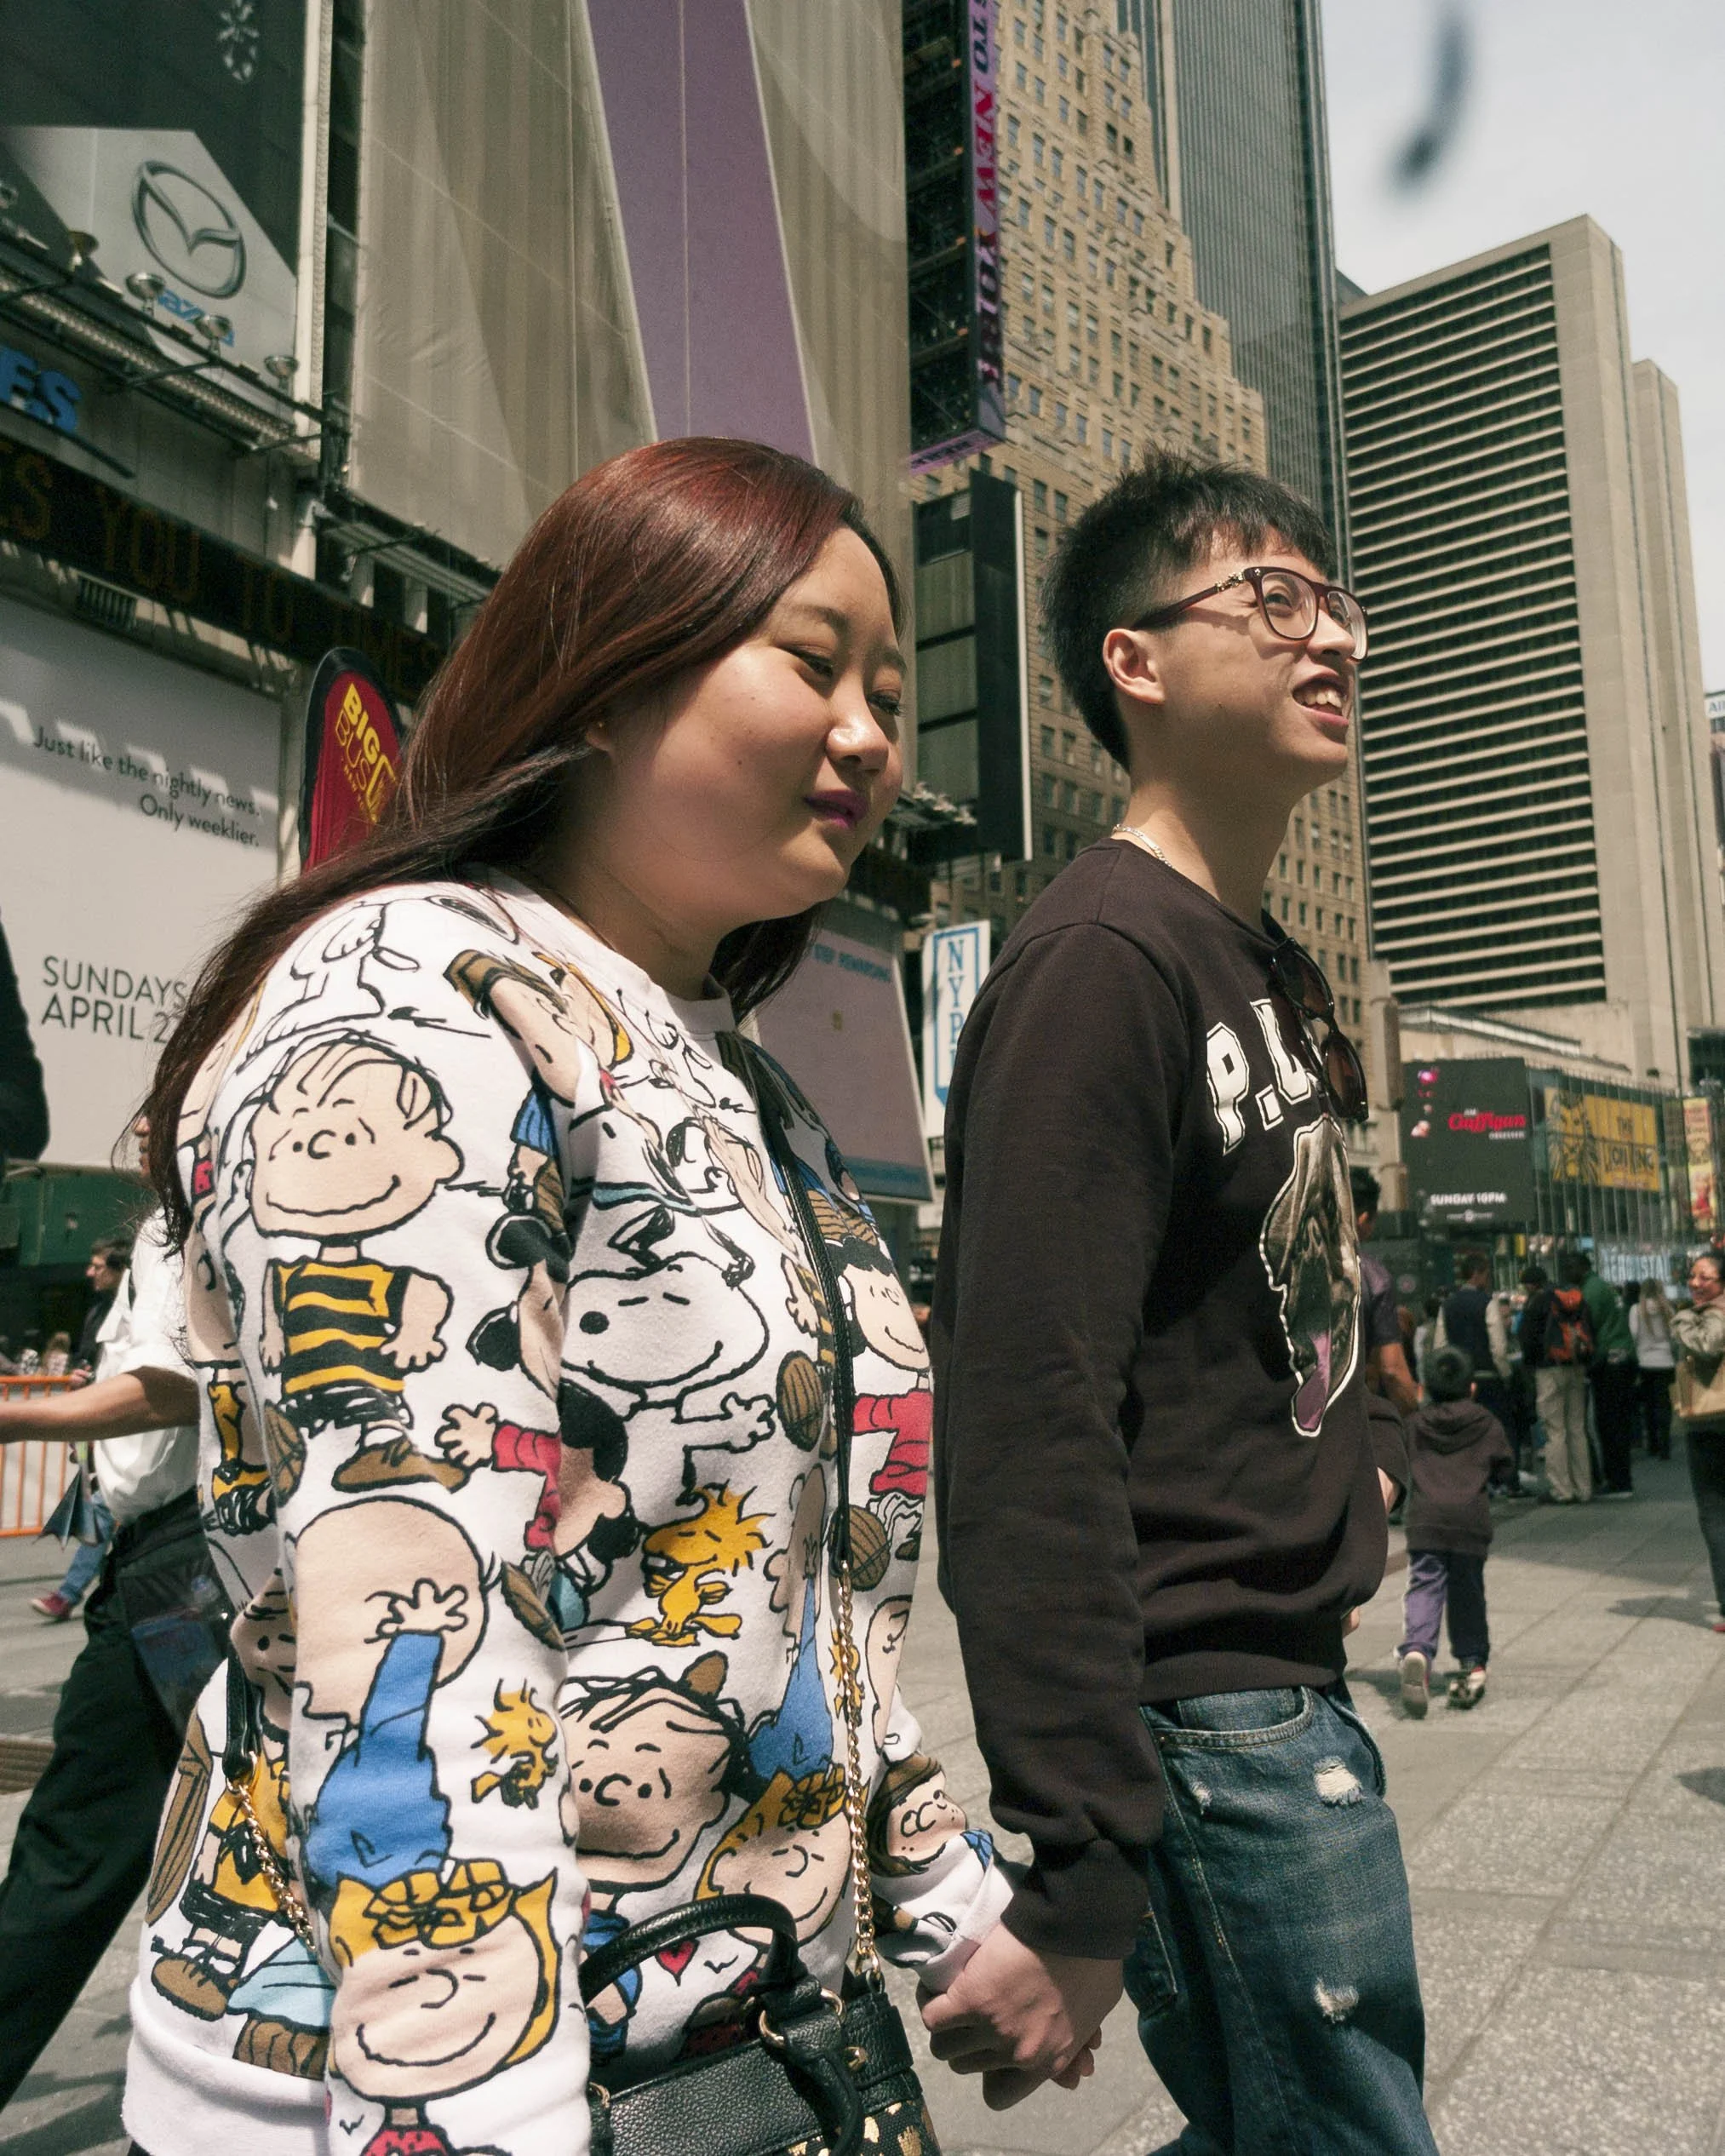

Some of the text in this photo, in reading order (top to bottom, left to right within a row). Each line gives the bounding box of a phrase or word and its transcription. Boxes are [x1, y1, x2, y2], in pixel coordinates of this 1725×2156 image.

[973, 81, 996, 220] NEW
[335, 709, 371, 791] BUS
[342, 683, 381, 765] BIG
[34, 725, 260, 817] Just like the nightly news.
[140, 793, 260, 846] Only weeklier.
[41, 993, 144, 1041] APRIL
[43, 955, 187, 1011] SUNDAYS
[1430, 1193, 1475, 1206] SUNDAY
